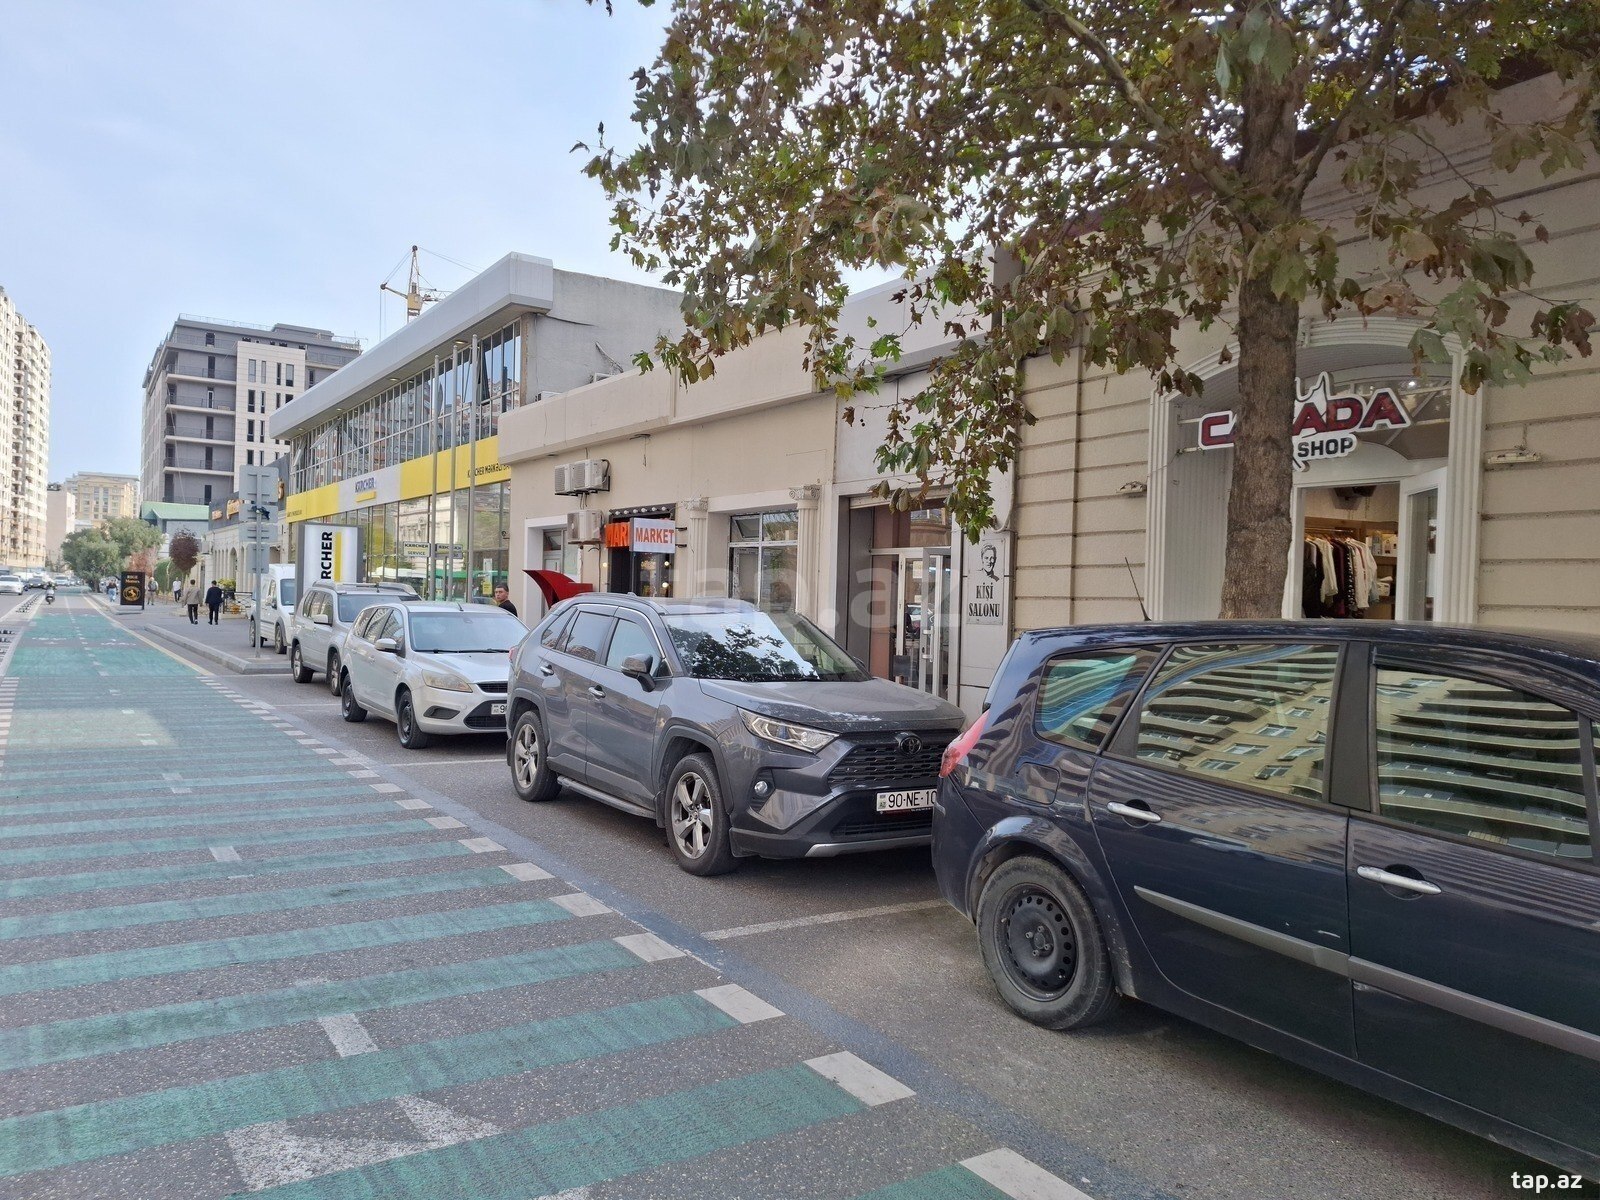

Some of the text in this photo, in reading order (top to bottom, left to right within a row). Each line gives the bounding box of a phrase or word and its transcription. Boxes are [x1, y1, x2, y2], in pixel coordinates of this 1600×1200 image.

[1201, 391, 1406, 447] CADA
[1297, 437, 1353, 458] SHOP
[635, 527, 674, 544] MARKET
[320, 531, 333, 580] RCHER
[976, 582, 993, 601] KİŞİ
[968, 602, 1000, 618] SALONU
[888, 790, 938, 808] 90-NE-10
